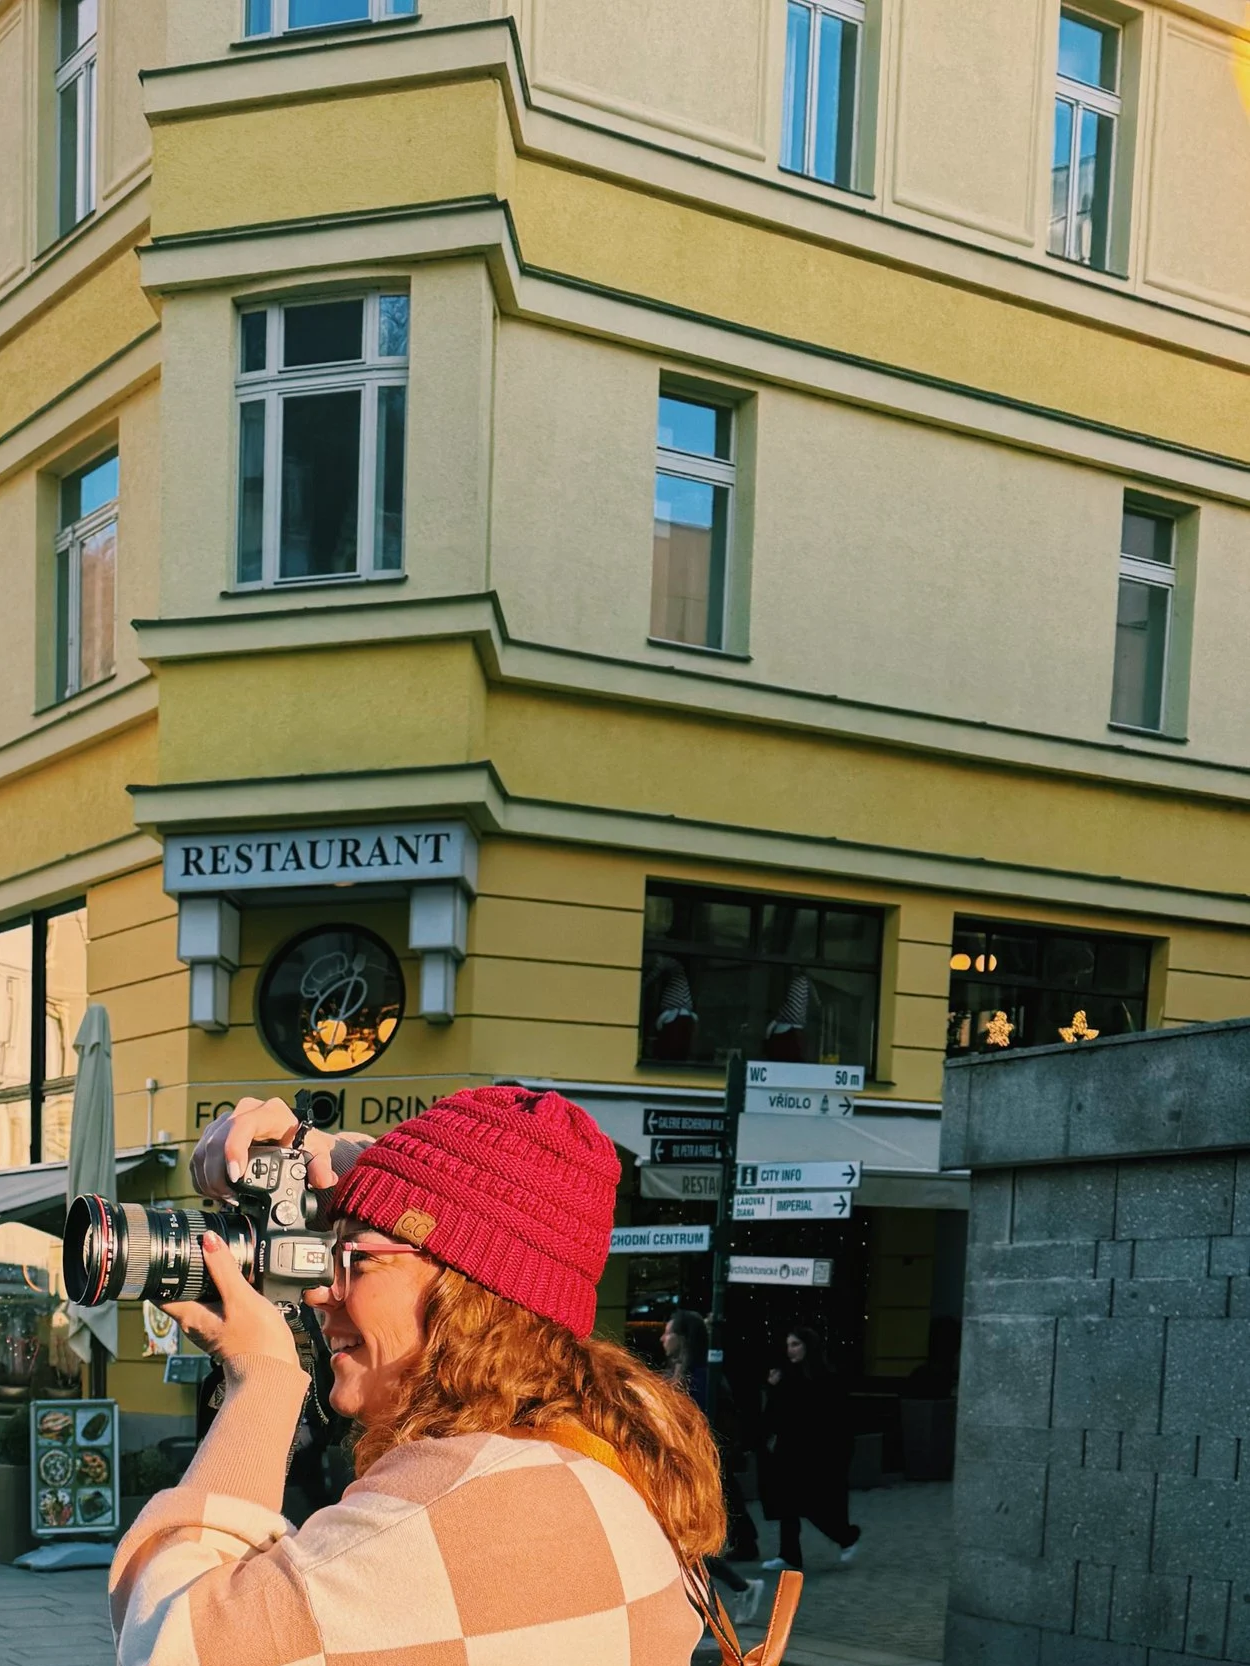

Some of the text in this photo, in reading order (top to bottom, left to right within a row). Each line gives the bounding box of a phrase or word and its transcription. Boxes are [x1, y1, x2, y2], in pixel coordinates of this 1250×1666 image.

[180, 832, 451, 877] RESTAURANT
[750, 1066, 860, 1087] WC 50 m
[361, 1095, 447, 1124] DRIN
[768, 1092, 812, 1110] VŘÍDLO
[682, 1175, 720, 1195] RESTA
[760, 1168, 802, 1182] CITY INFO
[776, 1199, 814, 1213] IMPERIAL
[653, 1232, 704, 1246] CENTRUM
[258, 1239, 266, 1273] Canon
